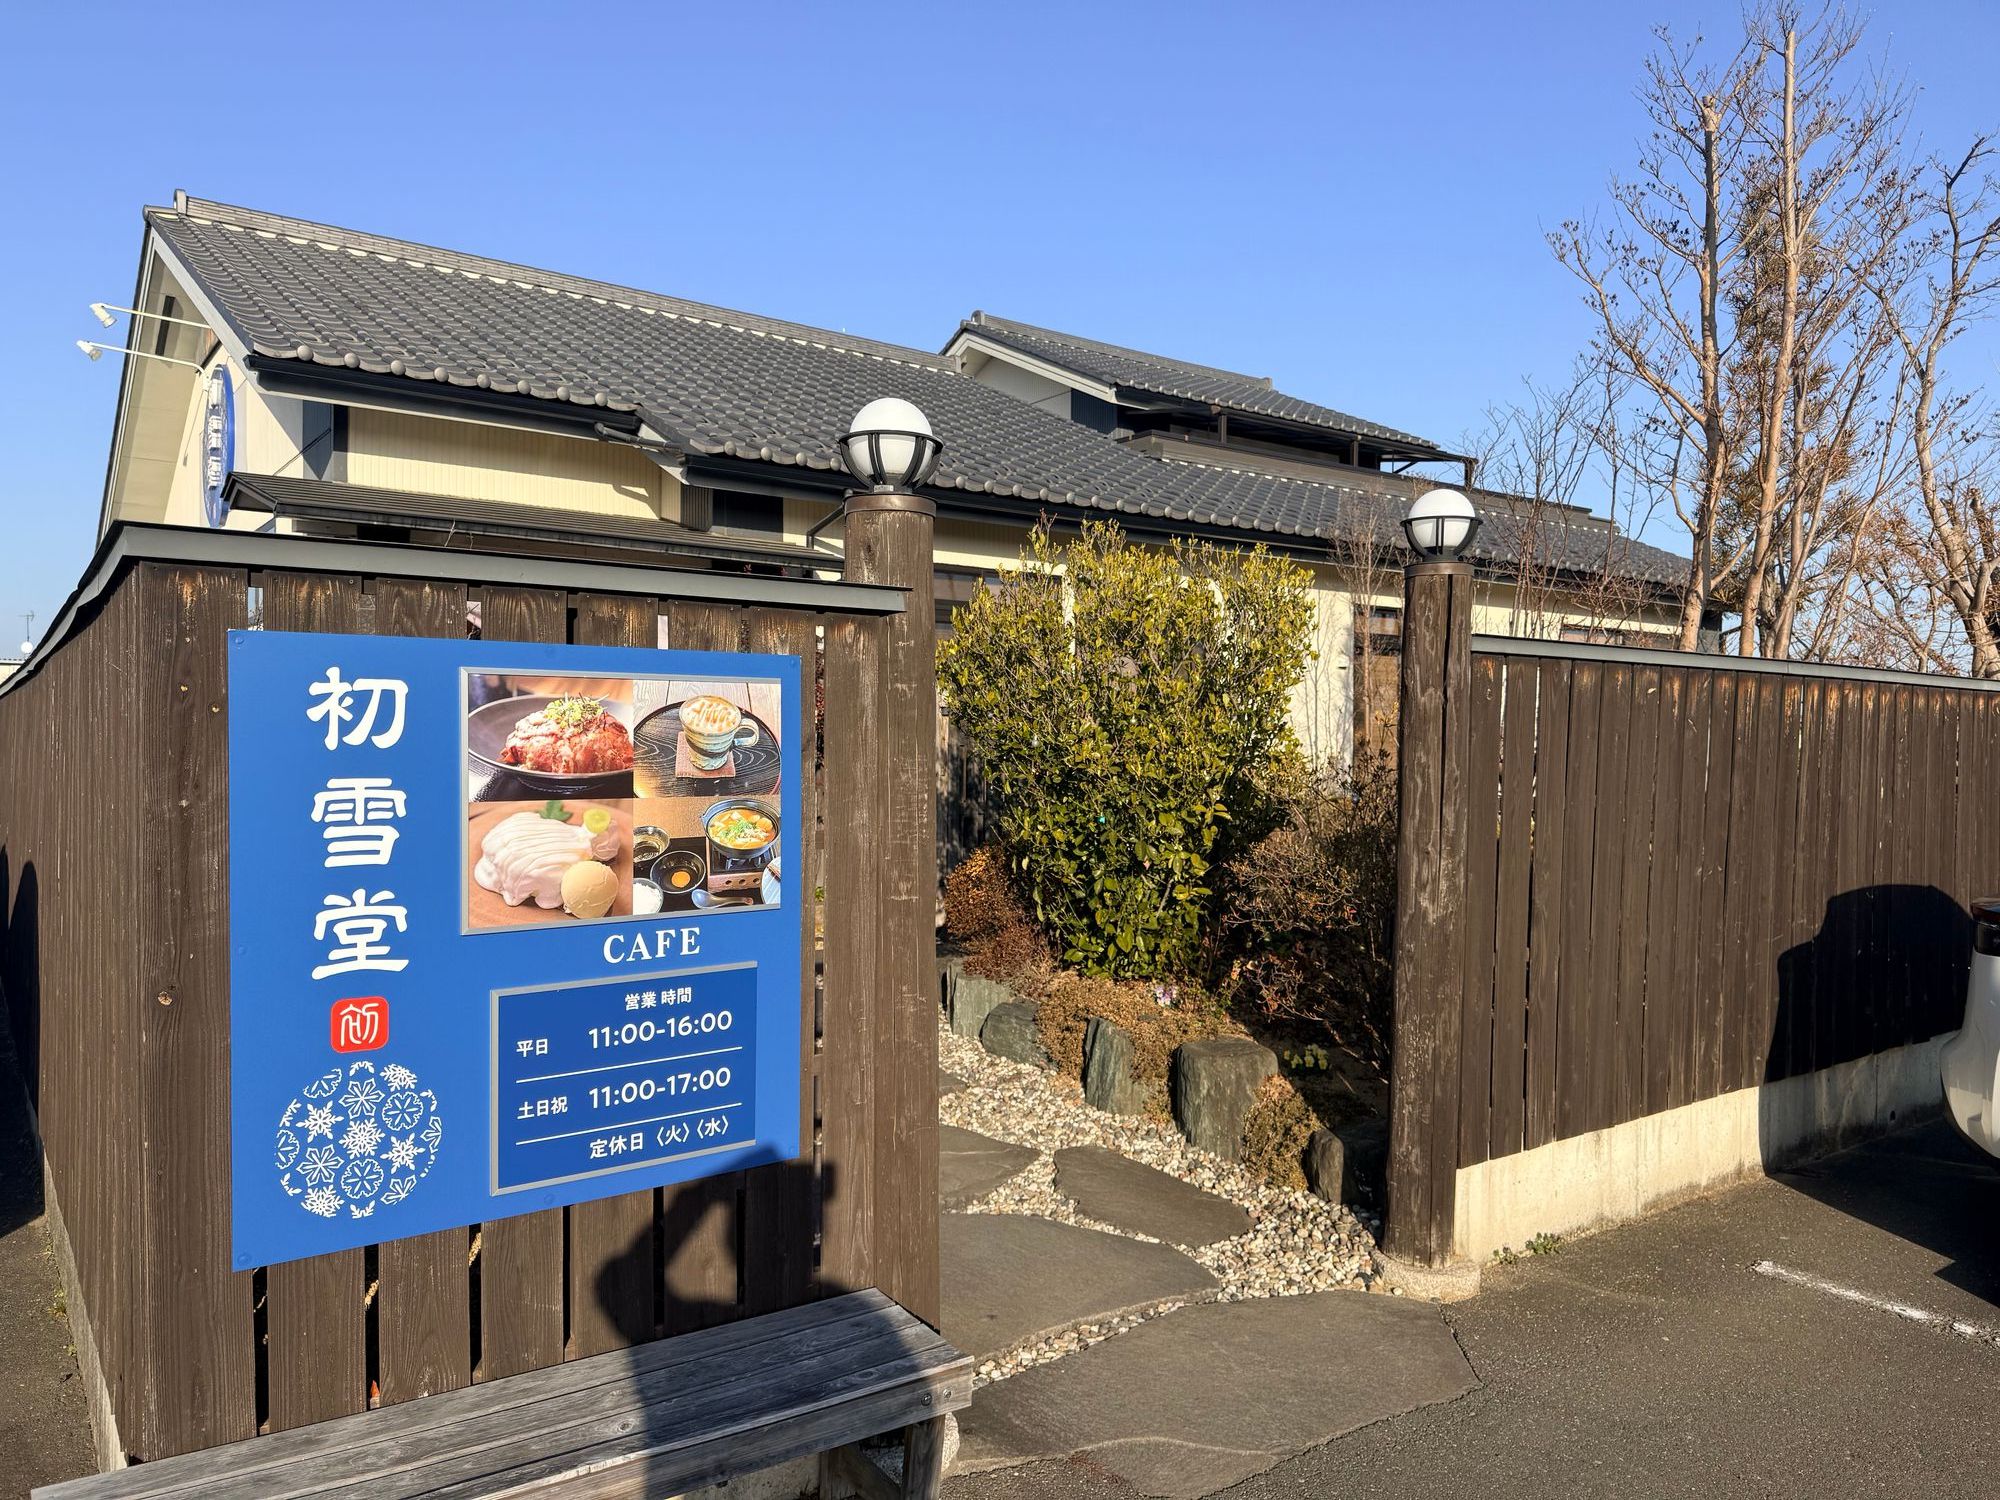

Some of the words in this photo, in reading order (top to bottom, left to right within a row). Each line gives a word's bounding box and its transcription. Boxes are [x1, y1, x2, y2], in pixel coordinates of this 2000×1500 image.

[306, 666, 410, 980] 初雪堂
[603, 927, 701, 963] CAFE
[624, 992, 657, 1011] 営業
[661, 987, 692, 1006] 時間
[516, 1038, 549, 1058] 平日
[588, 1010, 733, 1049] 11:00-16:00
[517, 1096, 568, 1120] 土日祝
[588, 1067, 731, 1109] 11:00-17:00
[589, 1132, 644, 1159] 定休日
